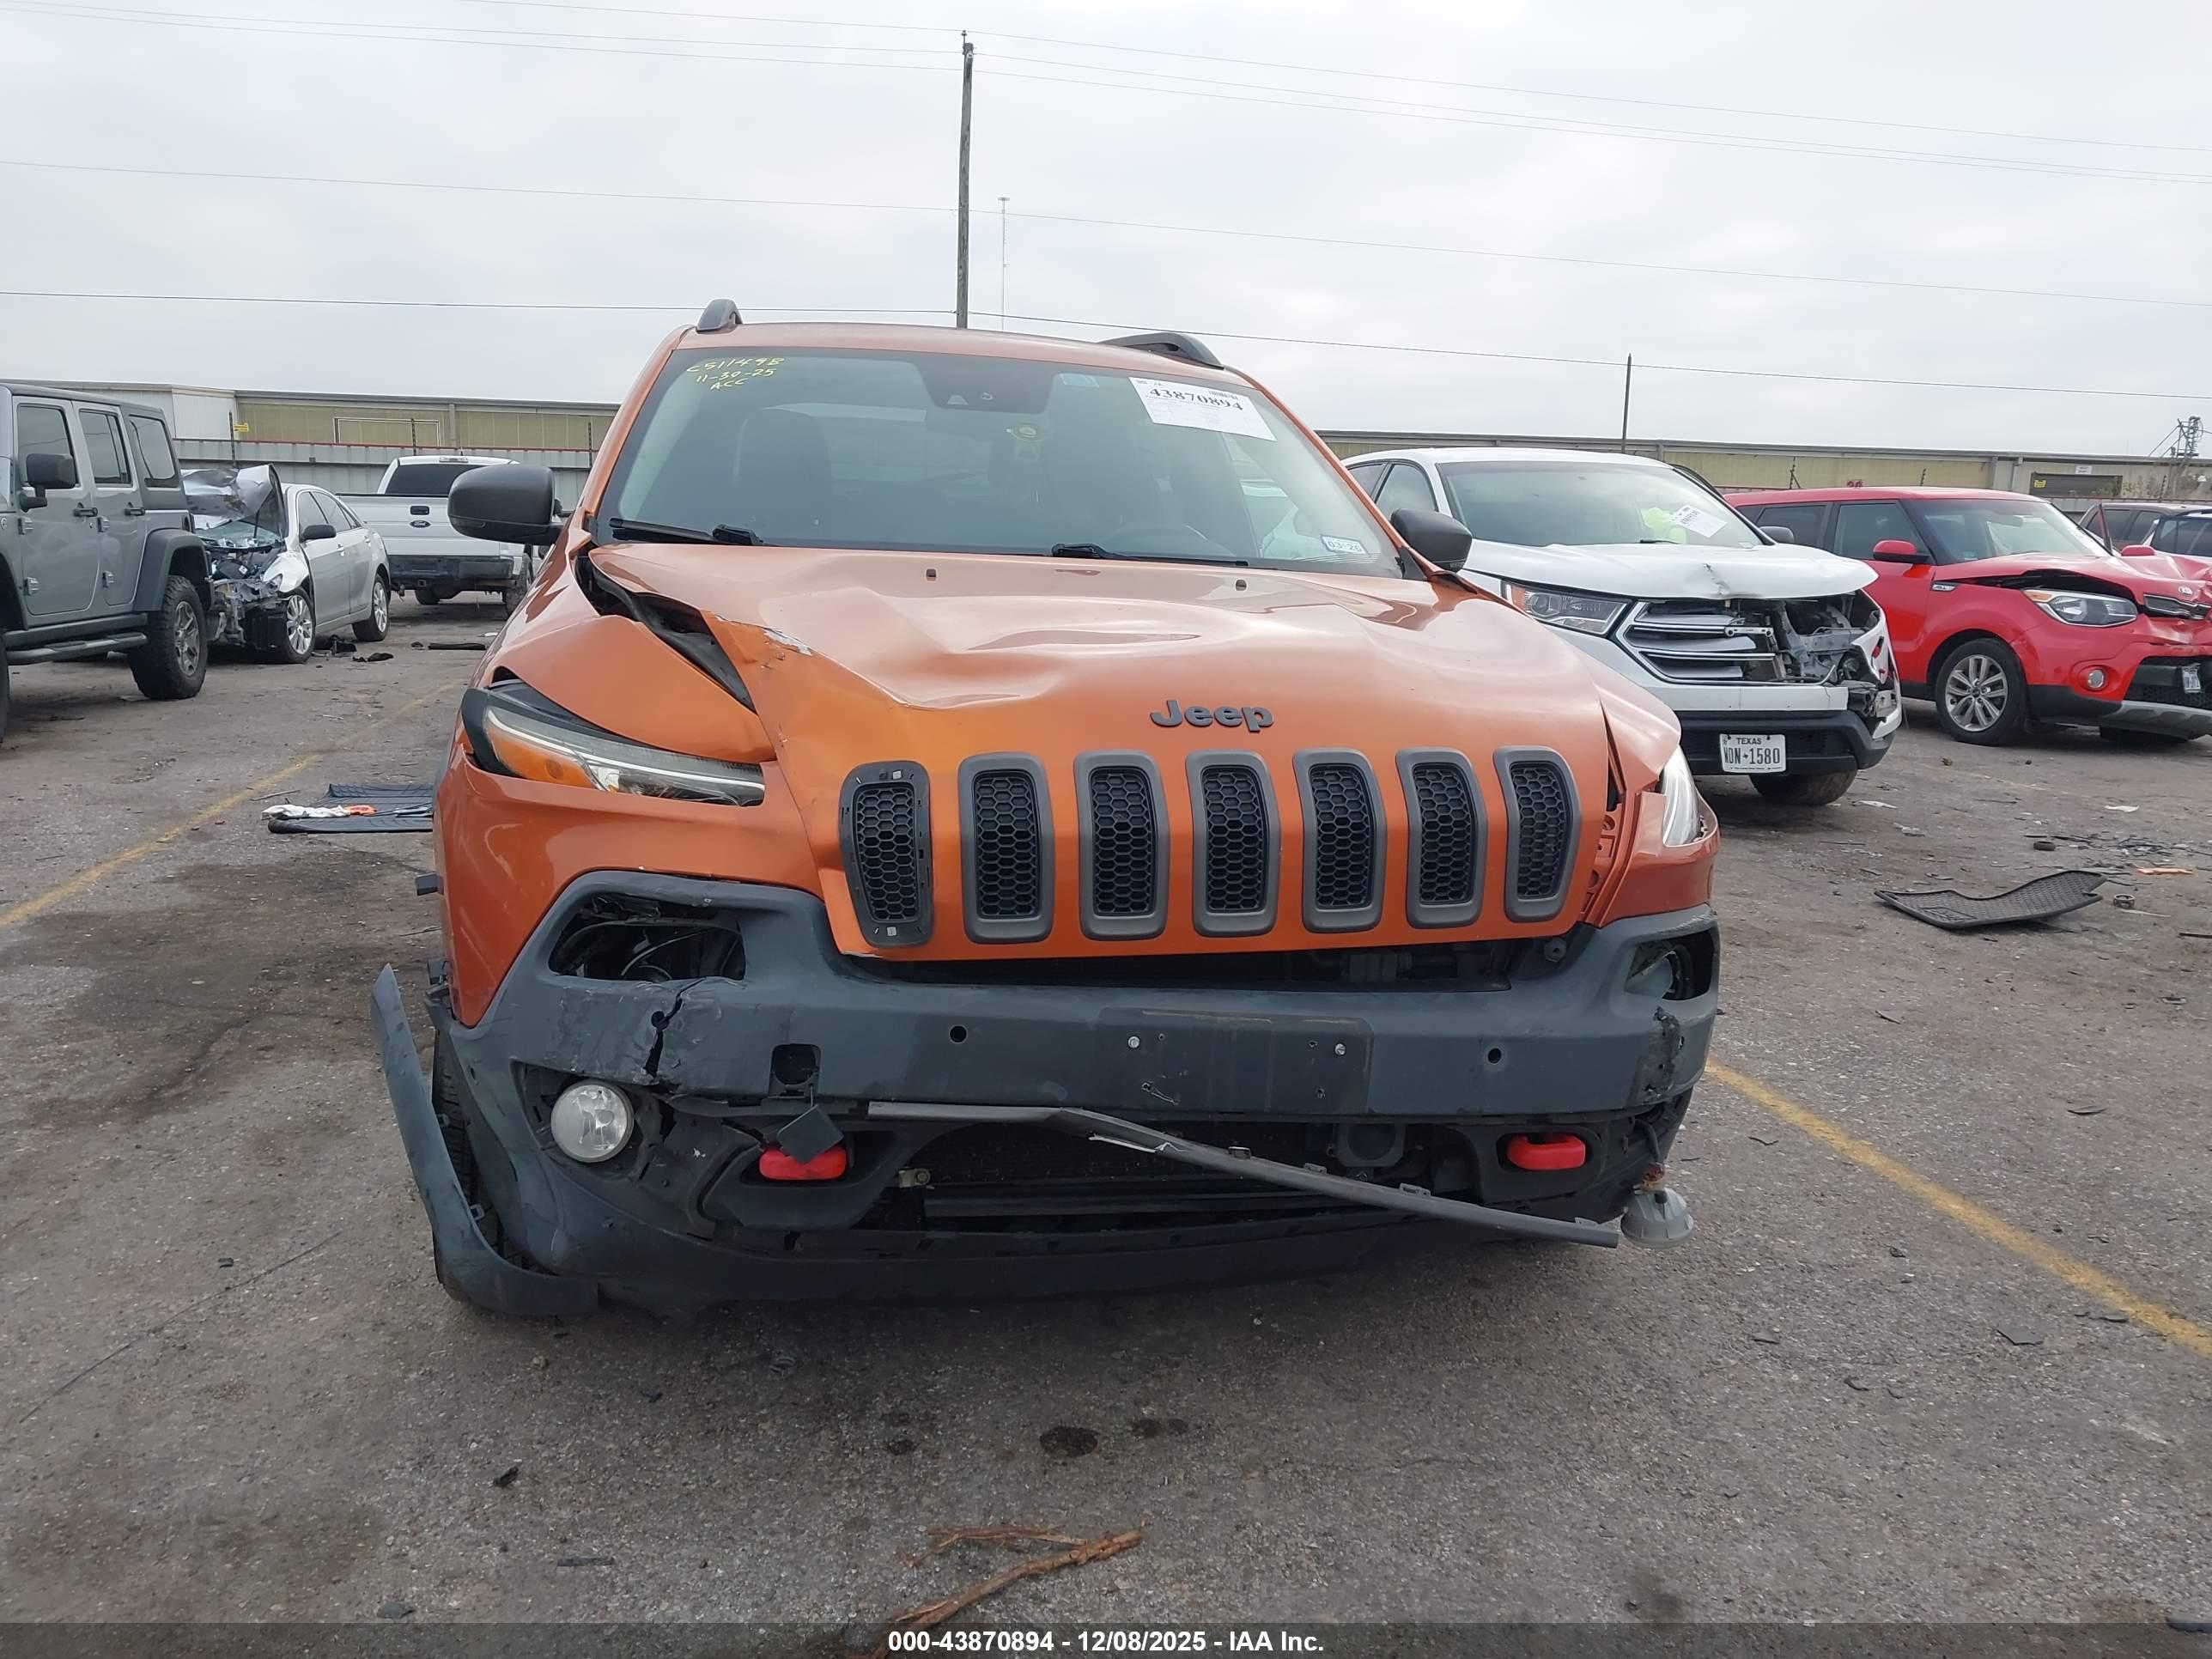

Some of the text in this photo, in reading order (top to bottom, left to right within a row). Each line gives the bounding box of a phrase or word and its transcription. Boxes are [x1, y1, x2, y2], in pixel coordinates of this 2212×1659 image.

[696, 368, 777, 383] 11-30-25
[709, 378, 749, 391] ACC
[1149, 388, 1243, 411] 43870894
[1149, 700, 1274, 733] Jeep
[1735, 737, 1762, 745] TEXAS
[1748, 747, 1780, 765] 1580
